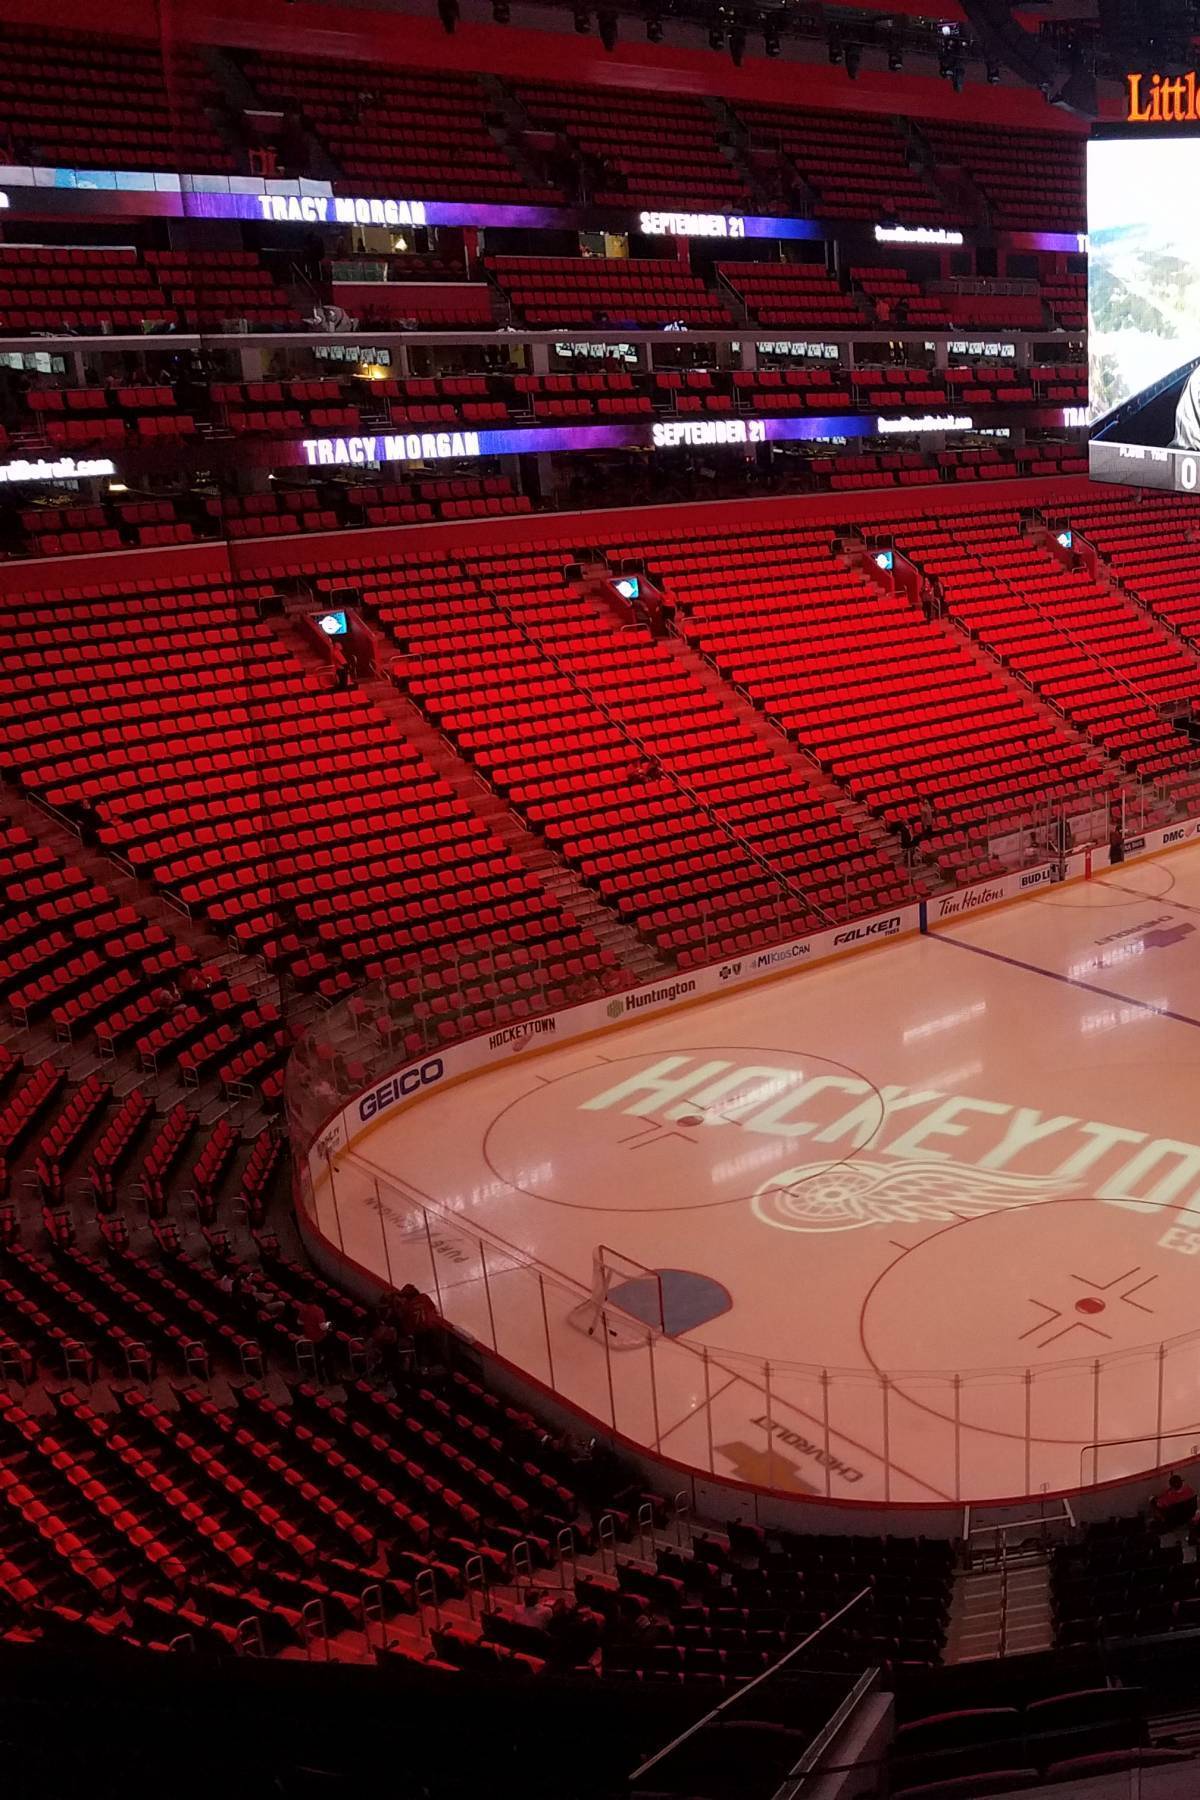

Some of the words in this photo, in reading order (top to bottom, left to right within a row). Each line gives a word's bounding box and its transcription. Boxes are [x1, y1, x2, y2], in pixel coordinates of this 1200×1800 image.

[258, 195, 327, 222] TRACY
[334, 197, 426, 225] MORGAN
[640, 211, 727, 237] SEPTEMBER
[728, 216, 745, 238] 21
[652, 419, 747, 447] SEPTEMBER
[749, 419, 766, 442] 21
[303, 437, 377, 465] TRACY
[384, 432, 481, 461] MORGAN
[1181, 457, 1197, 490] 0
[1162, 829, 1185, 844] DMC
[1021, 872, 1041, 886] BUD
[939, 895, 960, 917] Tim
[961, 888, 1004, 911] Hortons
[834, 917, 901, 946] FALKEN
[626, 979, 697, 1011] Huntington
[489, 1017, 556, 1050] HOCKEYTOWN
[358, 1058, 444, 1122] GEICO
